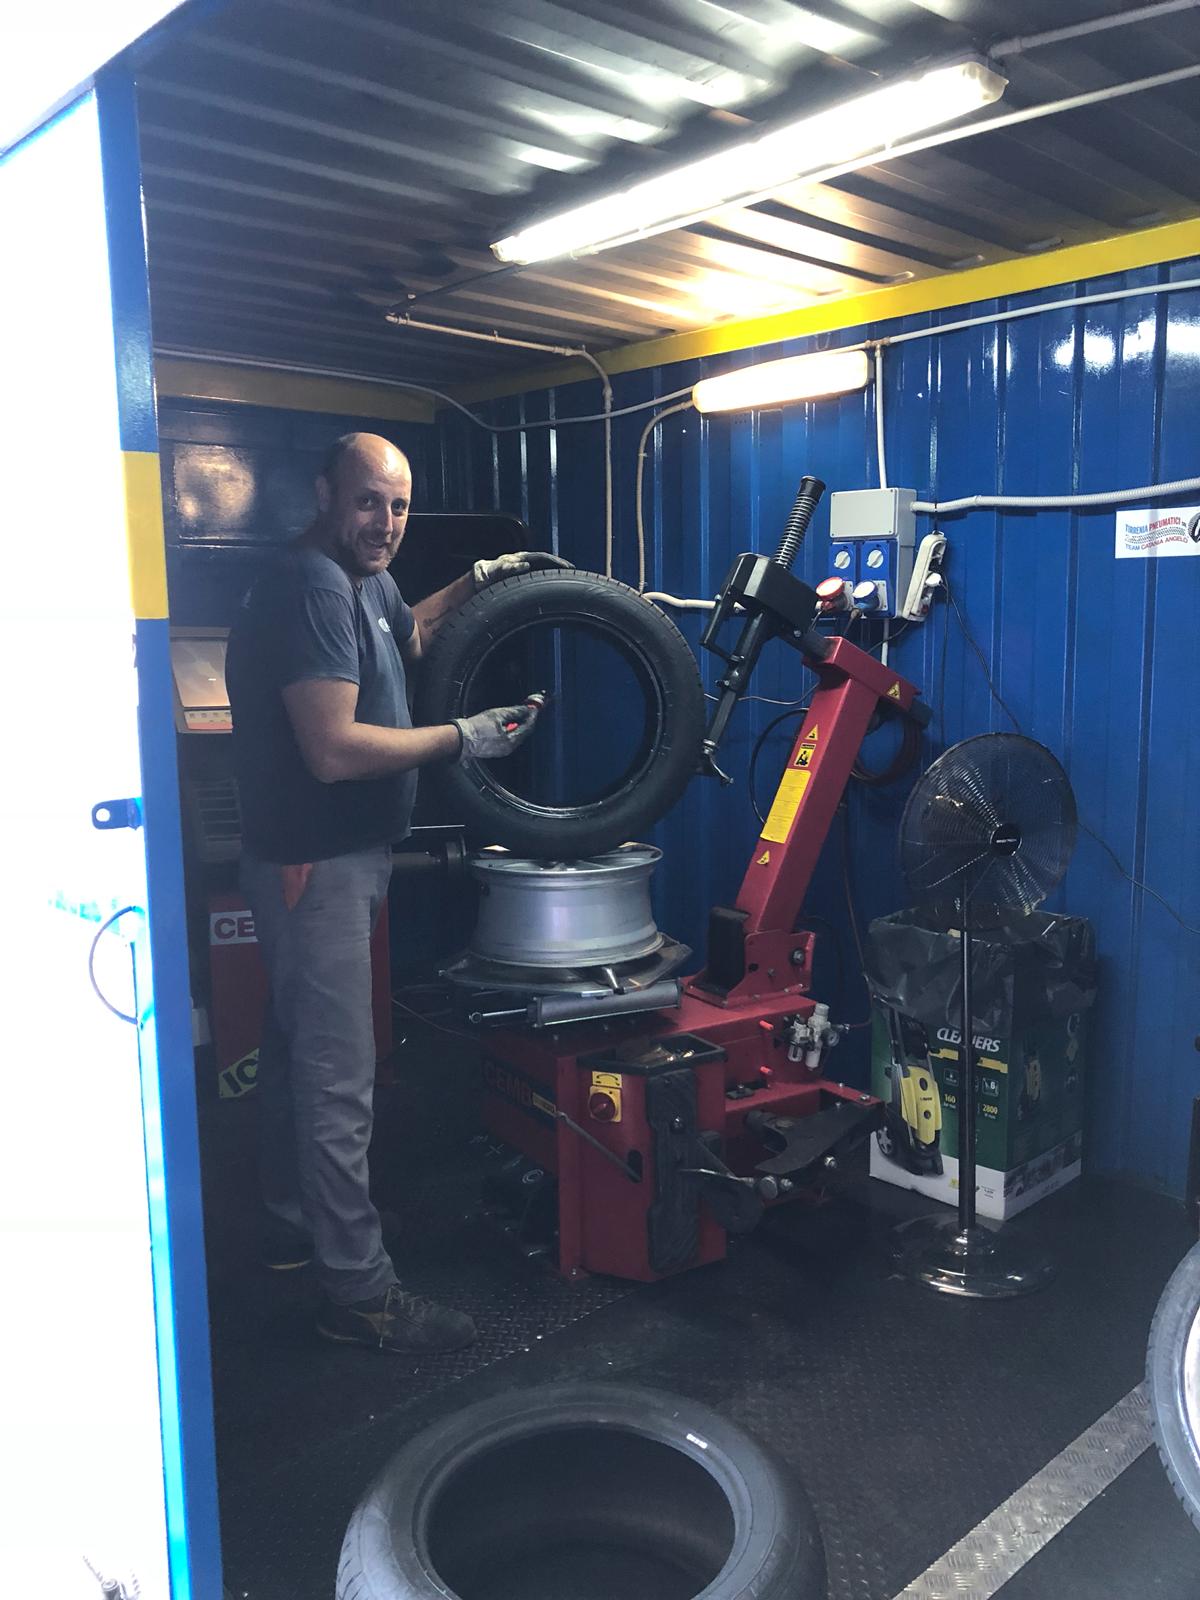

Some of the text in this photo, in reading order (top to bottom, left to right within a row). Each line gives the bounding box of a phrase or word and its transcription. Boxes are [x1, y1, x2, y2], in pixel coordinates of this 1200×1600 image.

[1149, 517, 1181, 531] PNEUMATICI
[944, 1093, 956, 1104] 160
[982, 1103, 998, 1115] 2800
